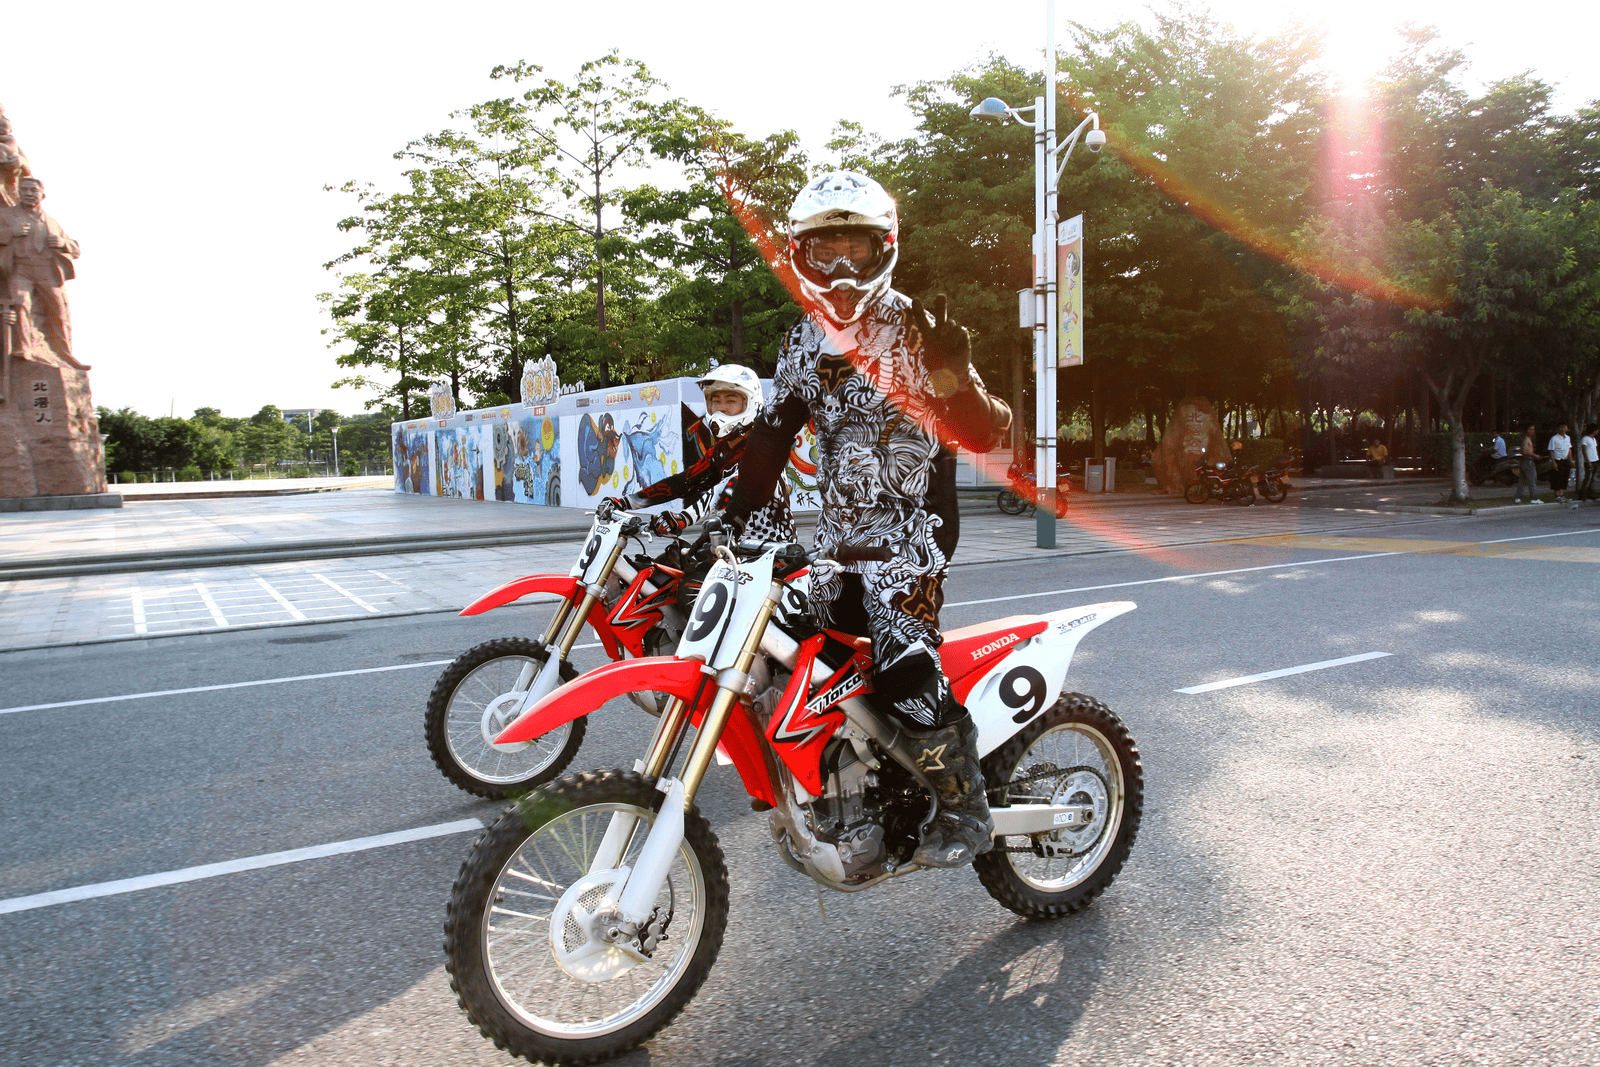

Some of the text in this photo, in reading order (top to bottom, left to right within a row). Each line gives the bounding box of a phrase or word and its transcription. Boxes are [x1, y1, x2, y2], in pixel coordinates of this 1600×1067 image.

[580, 535, 602, 570] 9
[686, 582, 728, 642] 9
[970, 633, 1020, 661] HONDA
[822, 673, 862, 708] Torco
[998, 665, 1047, 724] 9
